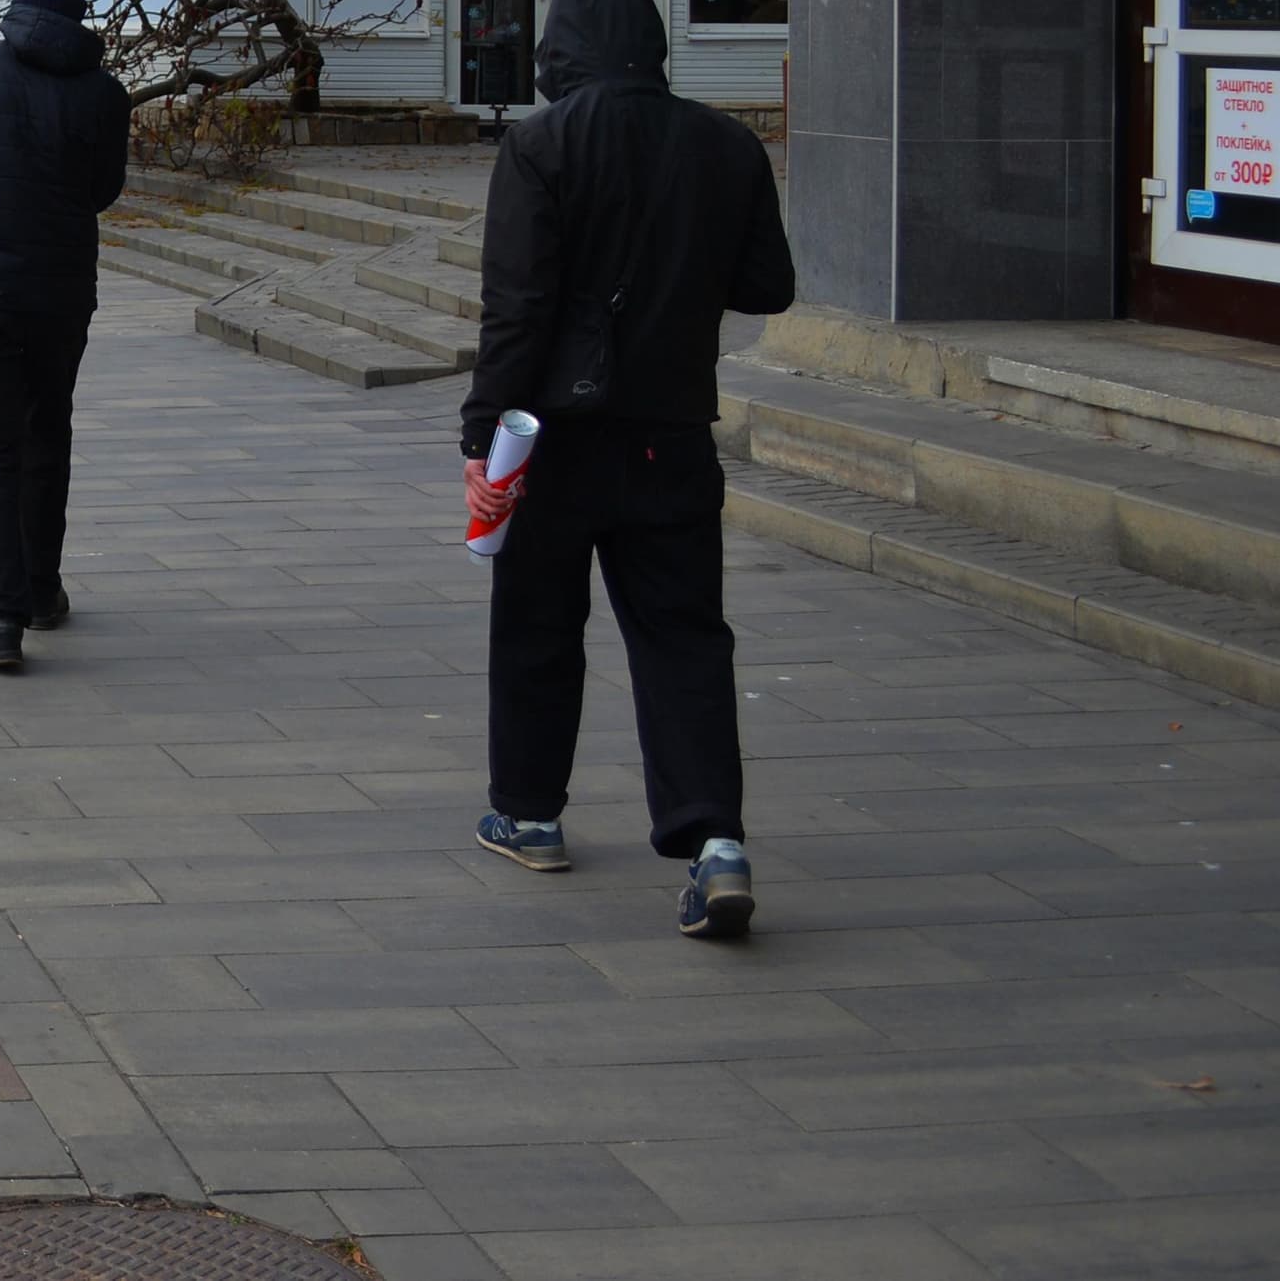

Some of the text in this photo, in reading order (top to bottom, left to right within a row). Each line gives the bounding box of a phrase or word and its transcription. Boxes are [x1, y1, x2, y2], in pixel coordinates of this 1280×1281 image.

[1215, 79, 1273, 94] ЗАЩИТНОЕ
[1223, 99, 1265, 112] СТЕКЛО
[1216, 135, 1272, 152] ПОКЛЕЙКА
